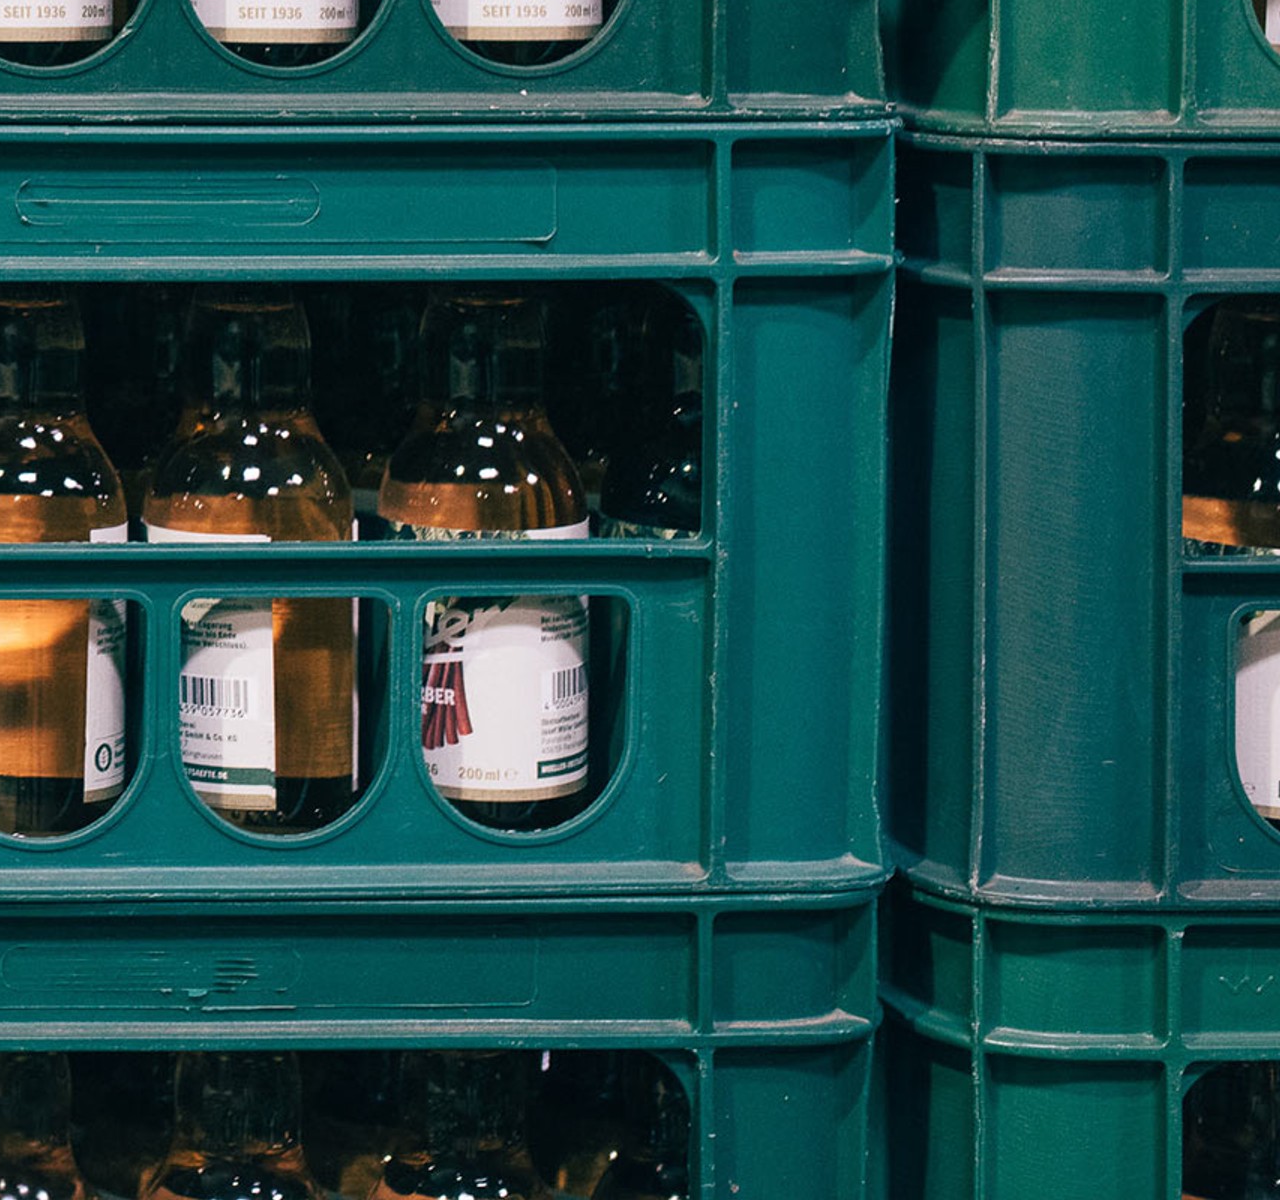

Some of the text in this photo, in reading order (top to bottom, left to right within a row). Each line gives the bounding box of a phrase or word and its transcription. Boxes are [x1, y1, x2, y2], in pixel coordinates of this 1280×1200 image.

[3, 6, 31, 19] SEIT
[37, 6, 66, 19] 1936
[239, 7, 266, 19] SEIT
[271, 7, 302, 19] 1936
[483, 5, 511, 18] SEIT
[516, 5, 547, 18] 1936
[458, 767, 482, 780] 200
